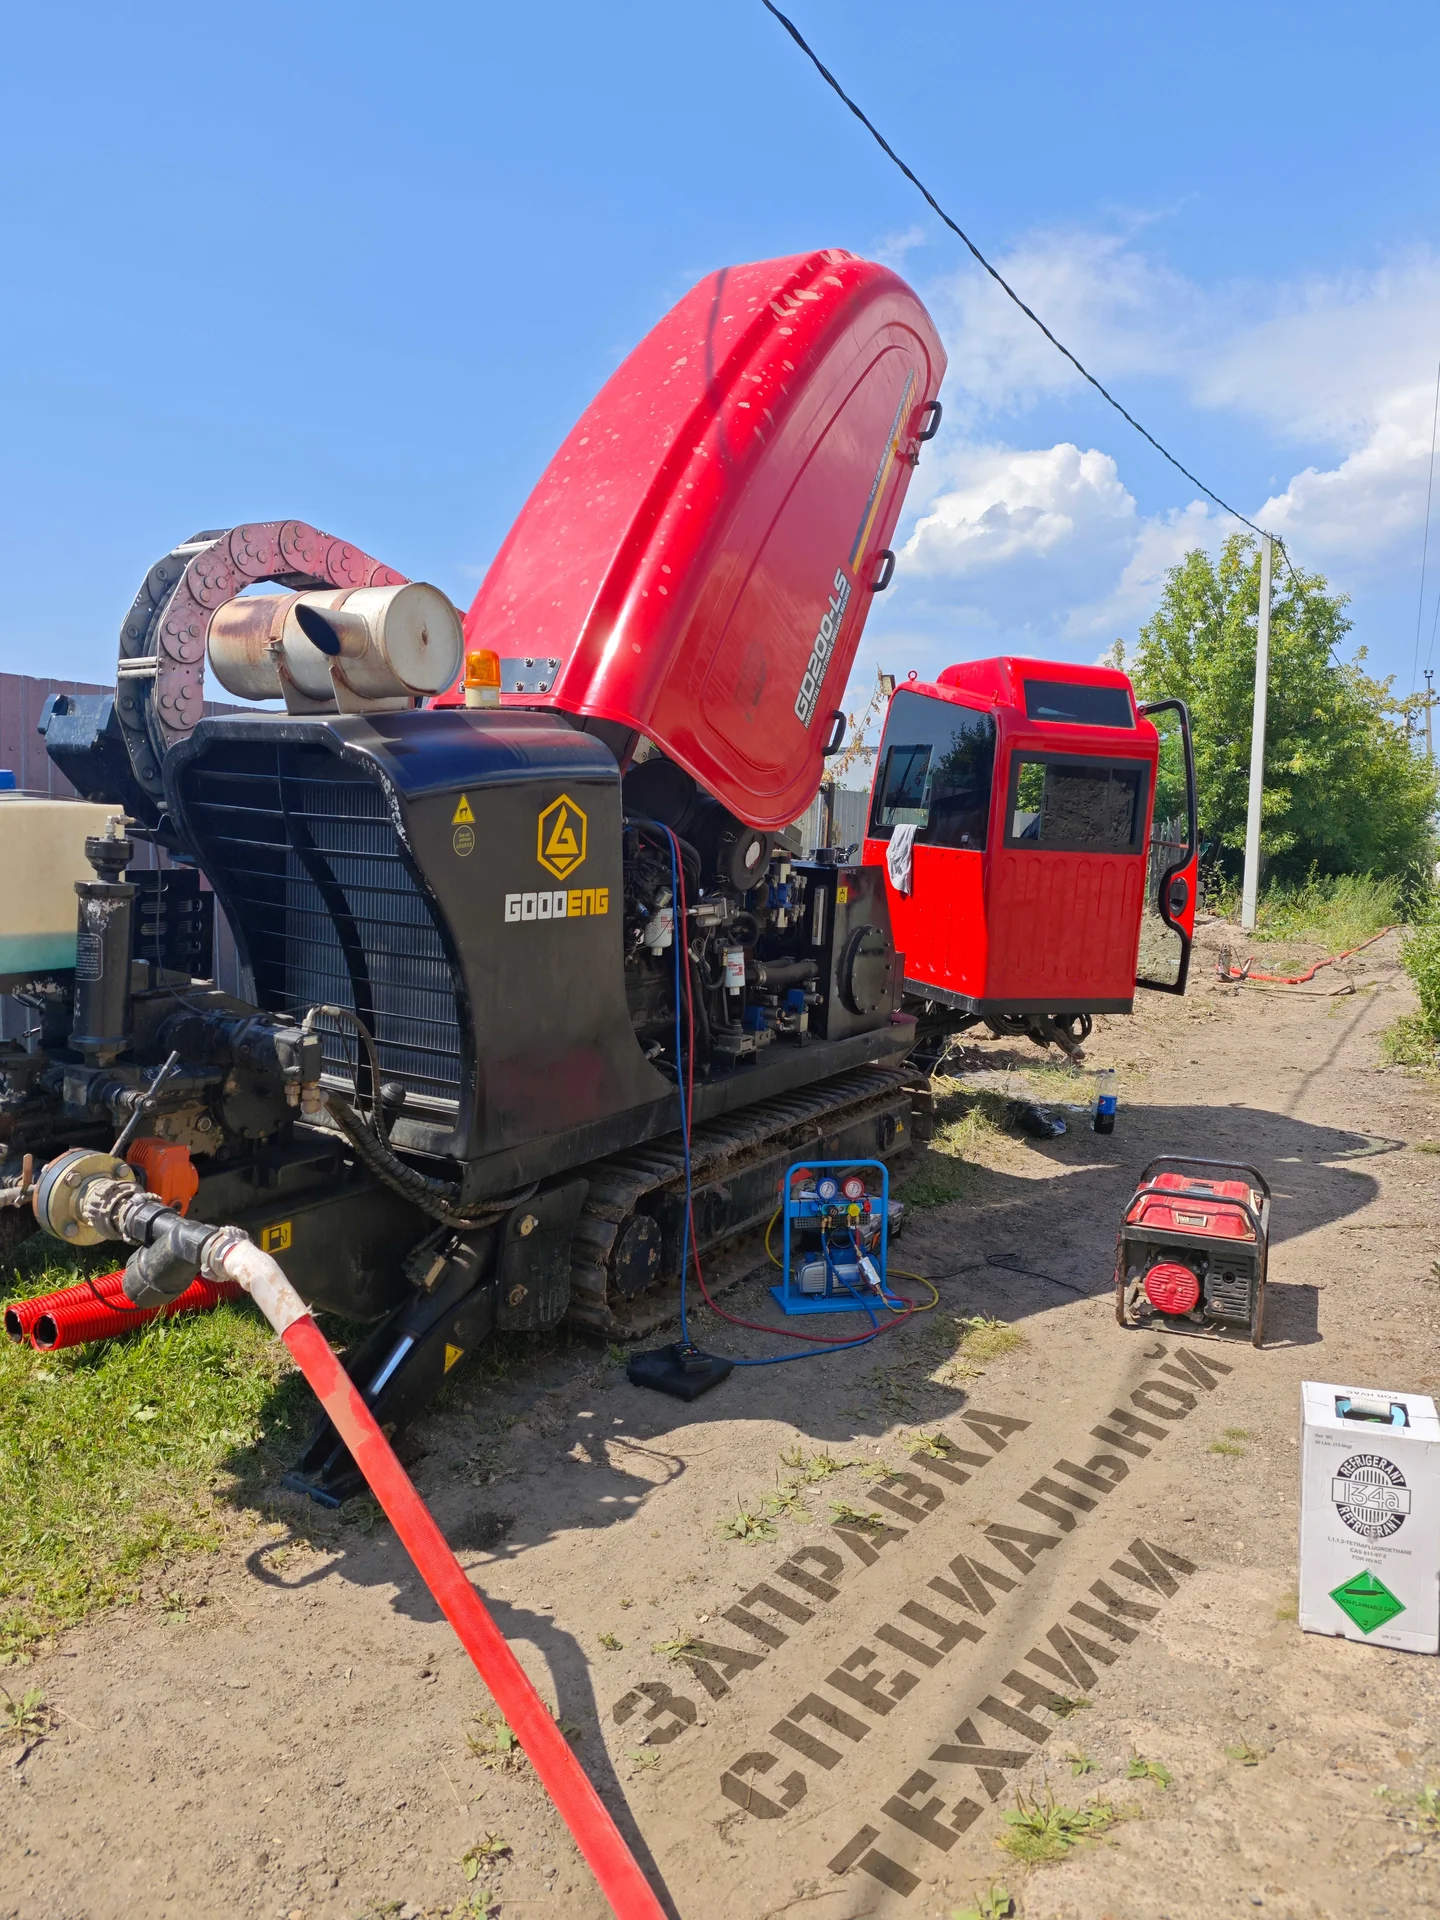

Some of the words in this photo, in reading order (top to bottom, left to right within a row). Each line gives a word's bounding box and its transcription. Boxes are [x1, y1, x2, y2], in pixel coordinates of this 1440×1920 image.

[793, 566, 848, 723] GD200-LS
[804, 687, 821, 729] HORIZONTAL
[818, 643, 834, 687] DIRECTIONAL
[830, 612, 844, 643] DRILLING
[840, 583, 852, 614] MACHINE
[504, 887, 609, 923] GOODENG
[1339, 1454, 1405, 1485] REFRIGERANT
[1344, 1482, 1400, 1512] 134a
[1338, 1506, 1402, 1538] REFRIGERANT
[1349, 1547, 1362, 1555] CAS
[1351, 1554, 1365, 1562] FOR
[1365, 1557, 1382, 1565] HVAC
[1339, 1597, 1383, 1612] NON-FLAMMABLE
